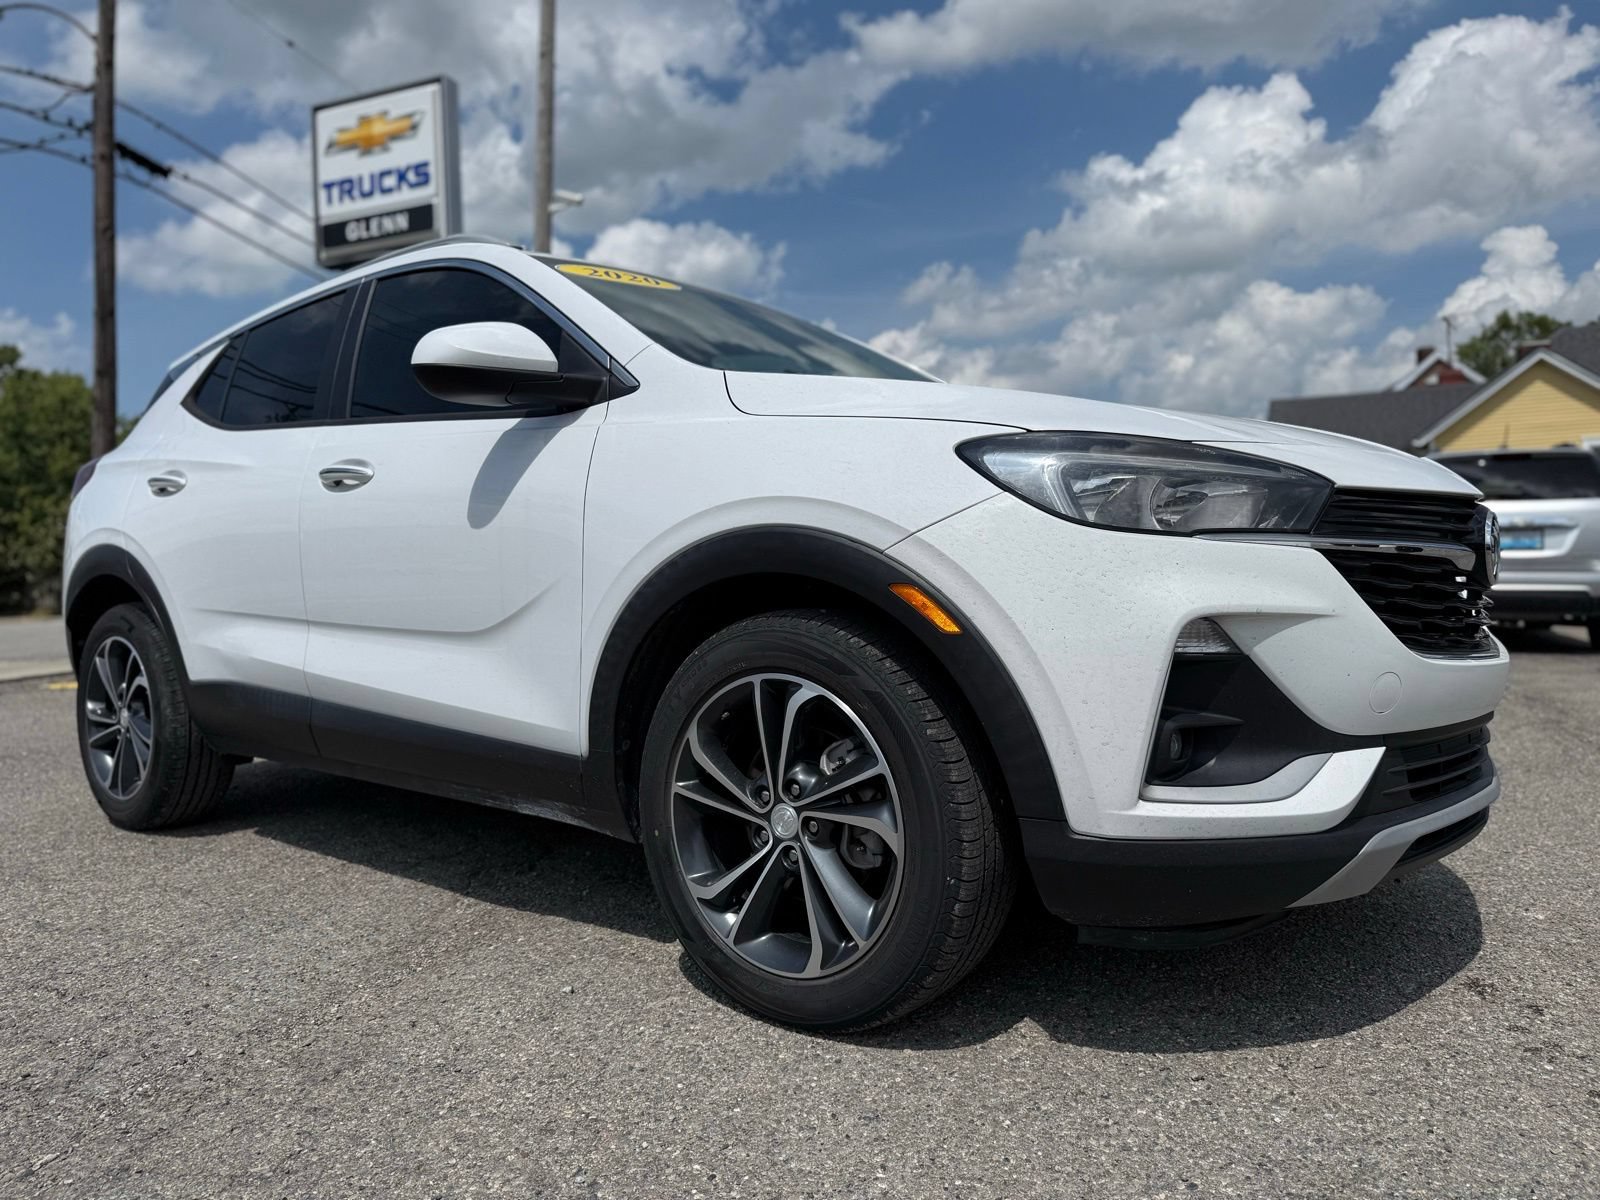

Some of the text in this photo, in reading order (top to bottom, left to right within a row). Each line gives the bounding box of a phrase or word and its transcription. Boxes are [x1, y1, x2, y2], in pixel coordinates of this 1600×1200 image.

[323, 161, 430, 205] TRUCKS
[345, 211, 410, 242] GLENN
[583, 267, 661, 286] 2020
